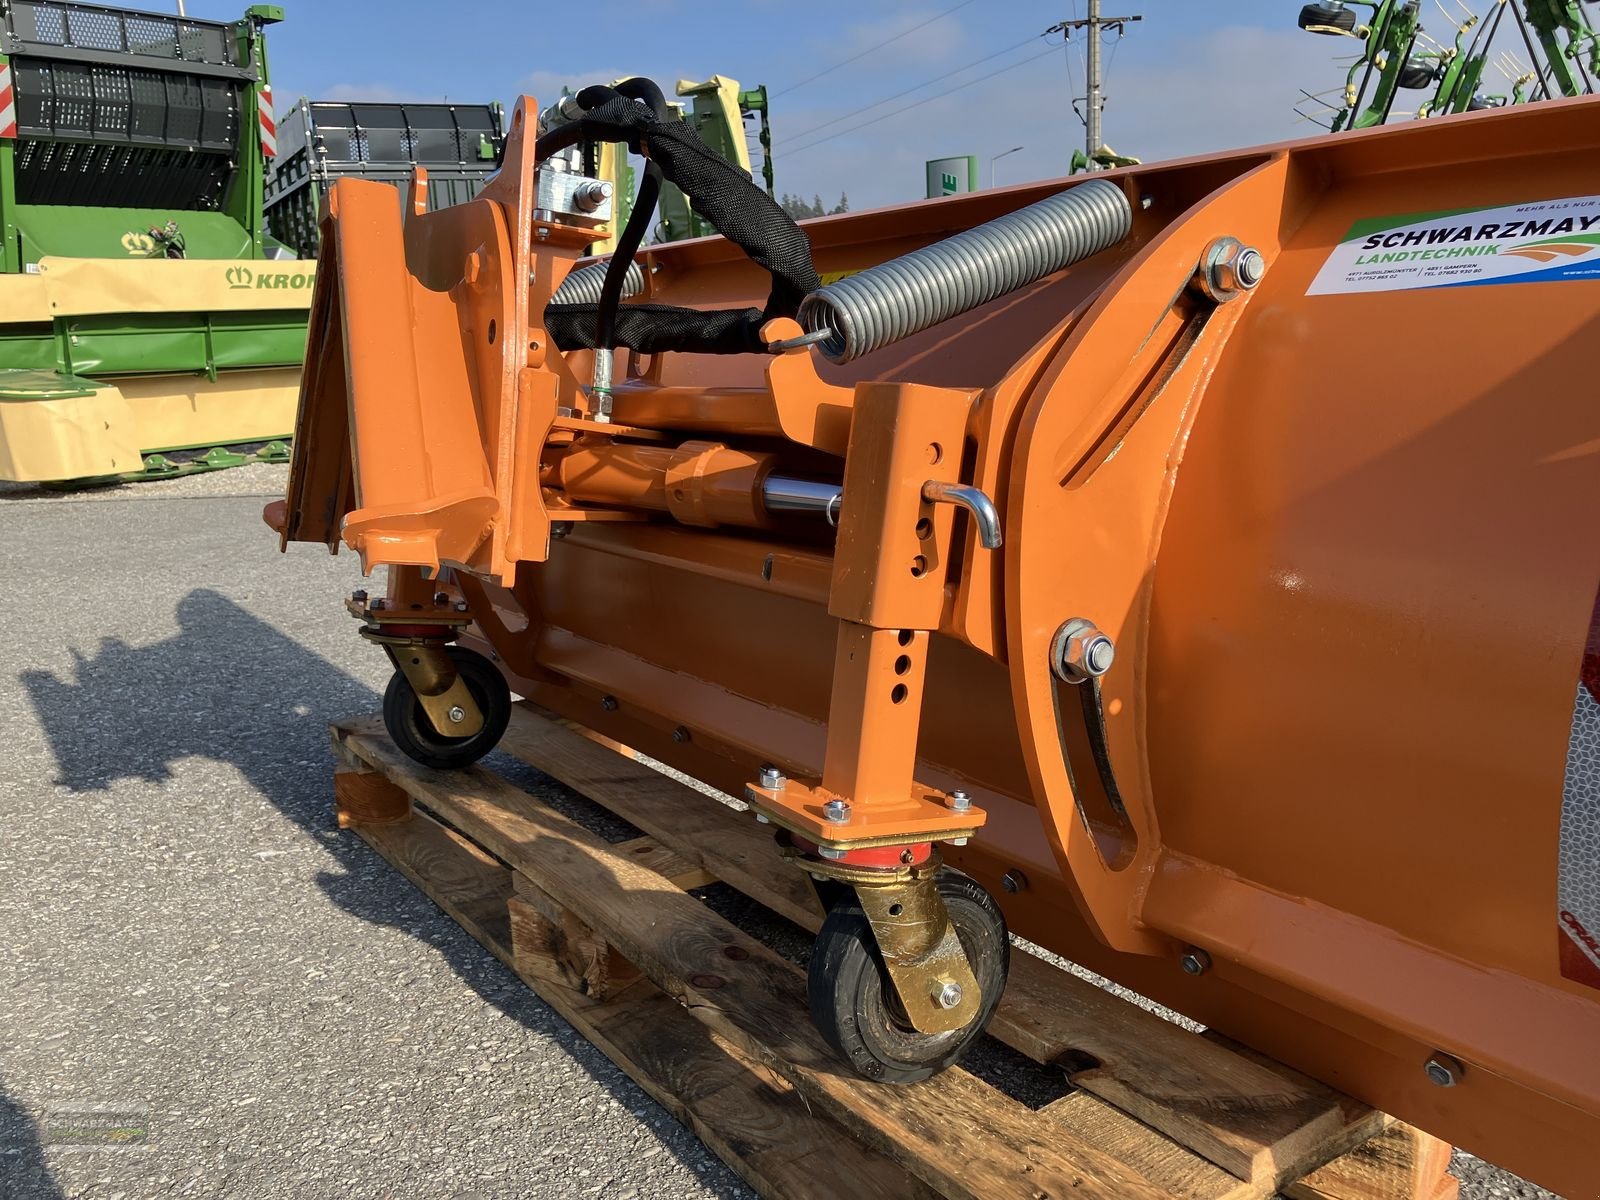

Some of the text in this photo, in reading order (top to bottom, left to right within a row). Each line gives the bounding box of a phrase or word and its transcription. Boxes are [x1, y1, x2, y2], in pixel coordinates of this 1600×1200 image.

[1516, 205, 1546, 213] MEHR
[1361, 215, 1600, 250] SCHWARZMAY
[1355, 244, 1502, 265] LANDTECHNIK
